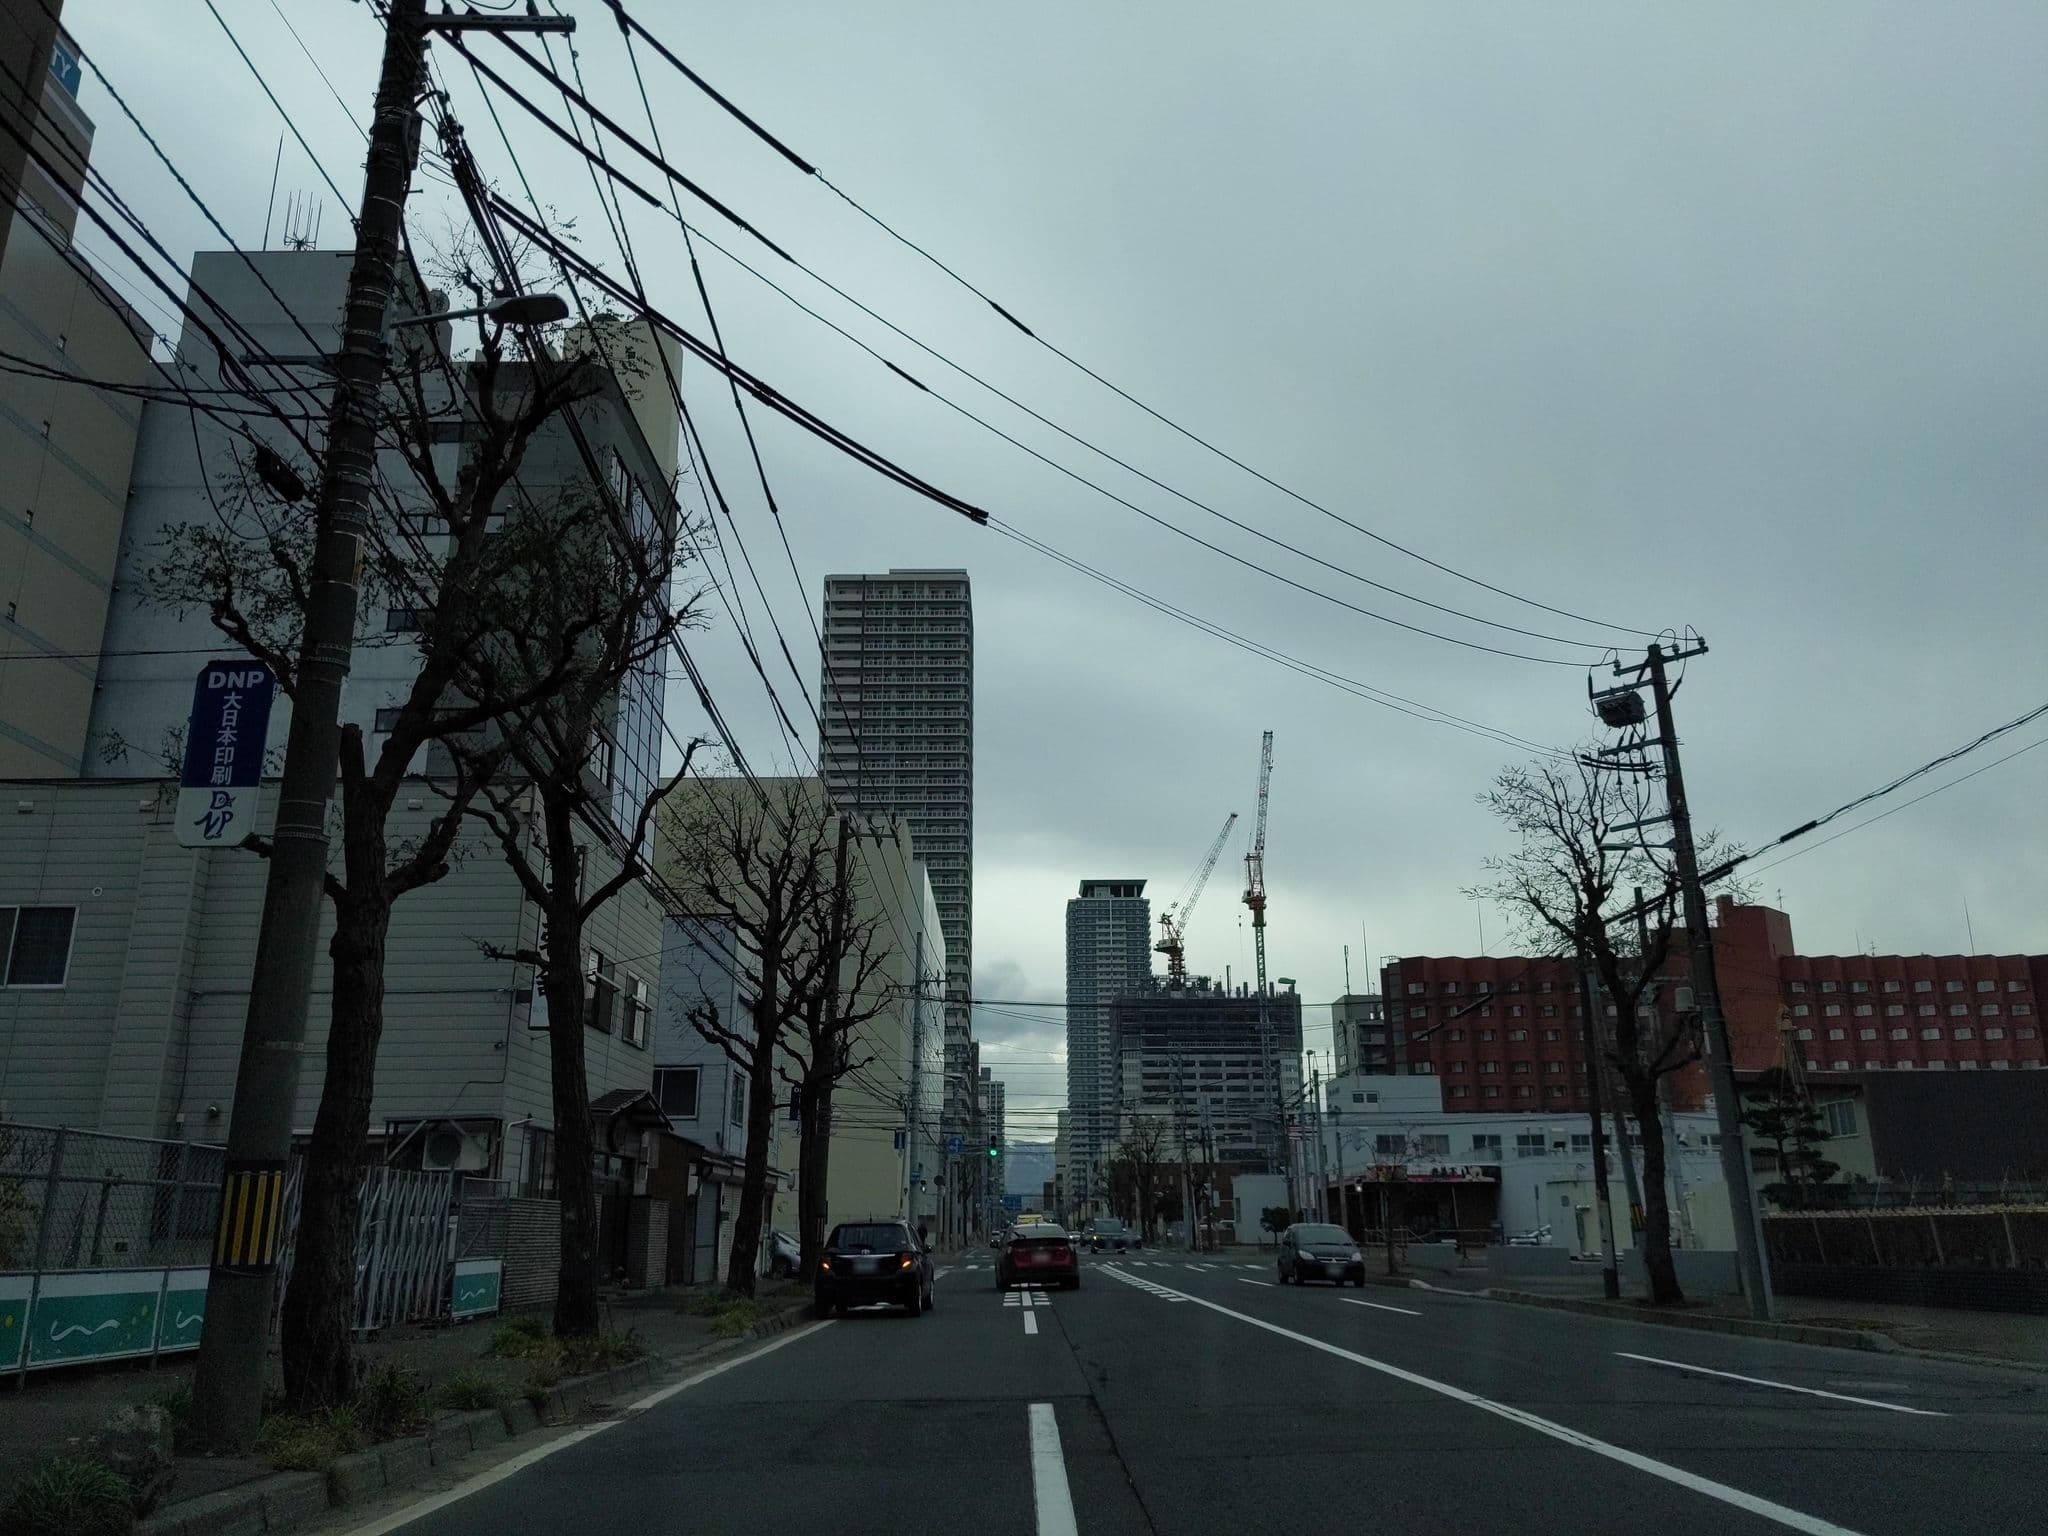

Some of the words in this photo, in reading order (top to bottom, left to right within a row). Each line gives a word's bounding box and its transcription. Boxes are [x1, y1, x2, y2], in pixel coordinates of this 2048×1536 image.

[208, 671, 265, 689] DNP
[210, 691, 243, 786] 大日本印刷
